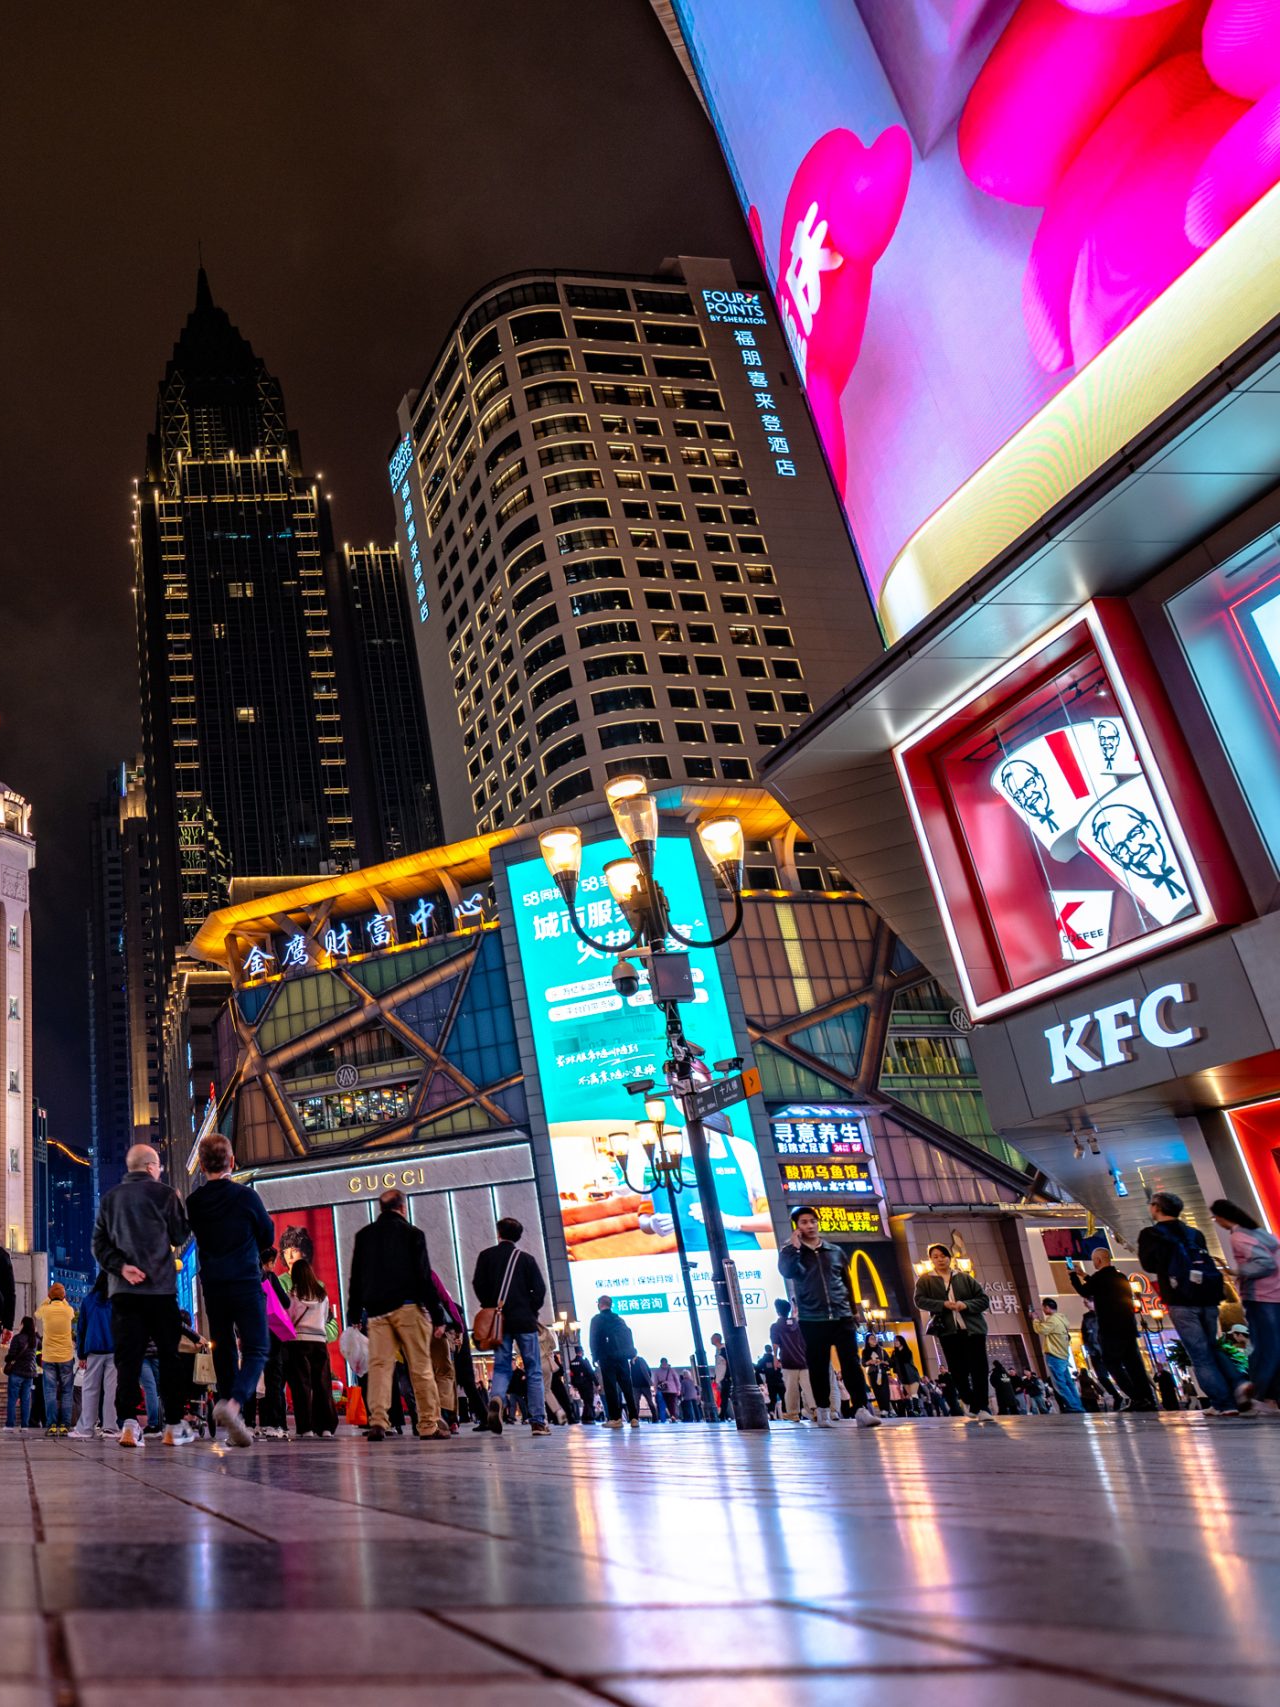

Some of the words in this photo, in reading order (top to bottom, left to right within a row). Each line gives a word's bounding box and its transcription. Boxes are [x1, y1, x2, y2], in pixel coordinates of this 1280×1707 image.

[702, 290, 746, 305] FOUR
[706, 302, 764, 317] POINTS
[723, 315, 767, 326] SHERATON
[734, 330, 797, 478] 福朋喜来登酒店
[243, 892, 485, 976] 金鹰财富中心
[1062, 929, 1105, 944] COFFEE
[1043, 982, 1200, 1085] KFC
[774, 1122, 862, 1144] 寻意养生
[784, 1165, 858, 1179] 酸汤乌鱼馆
[348, 1168, 425, 1193] GUCCI
[618, 1298, 663, 1312] 招商咨询
